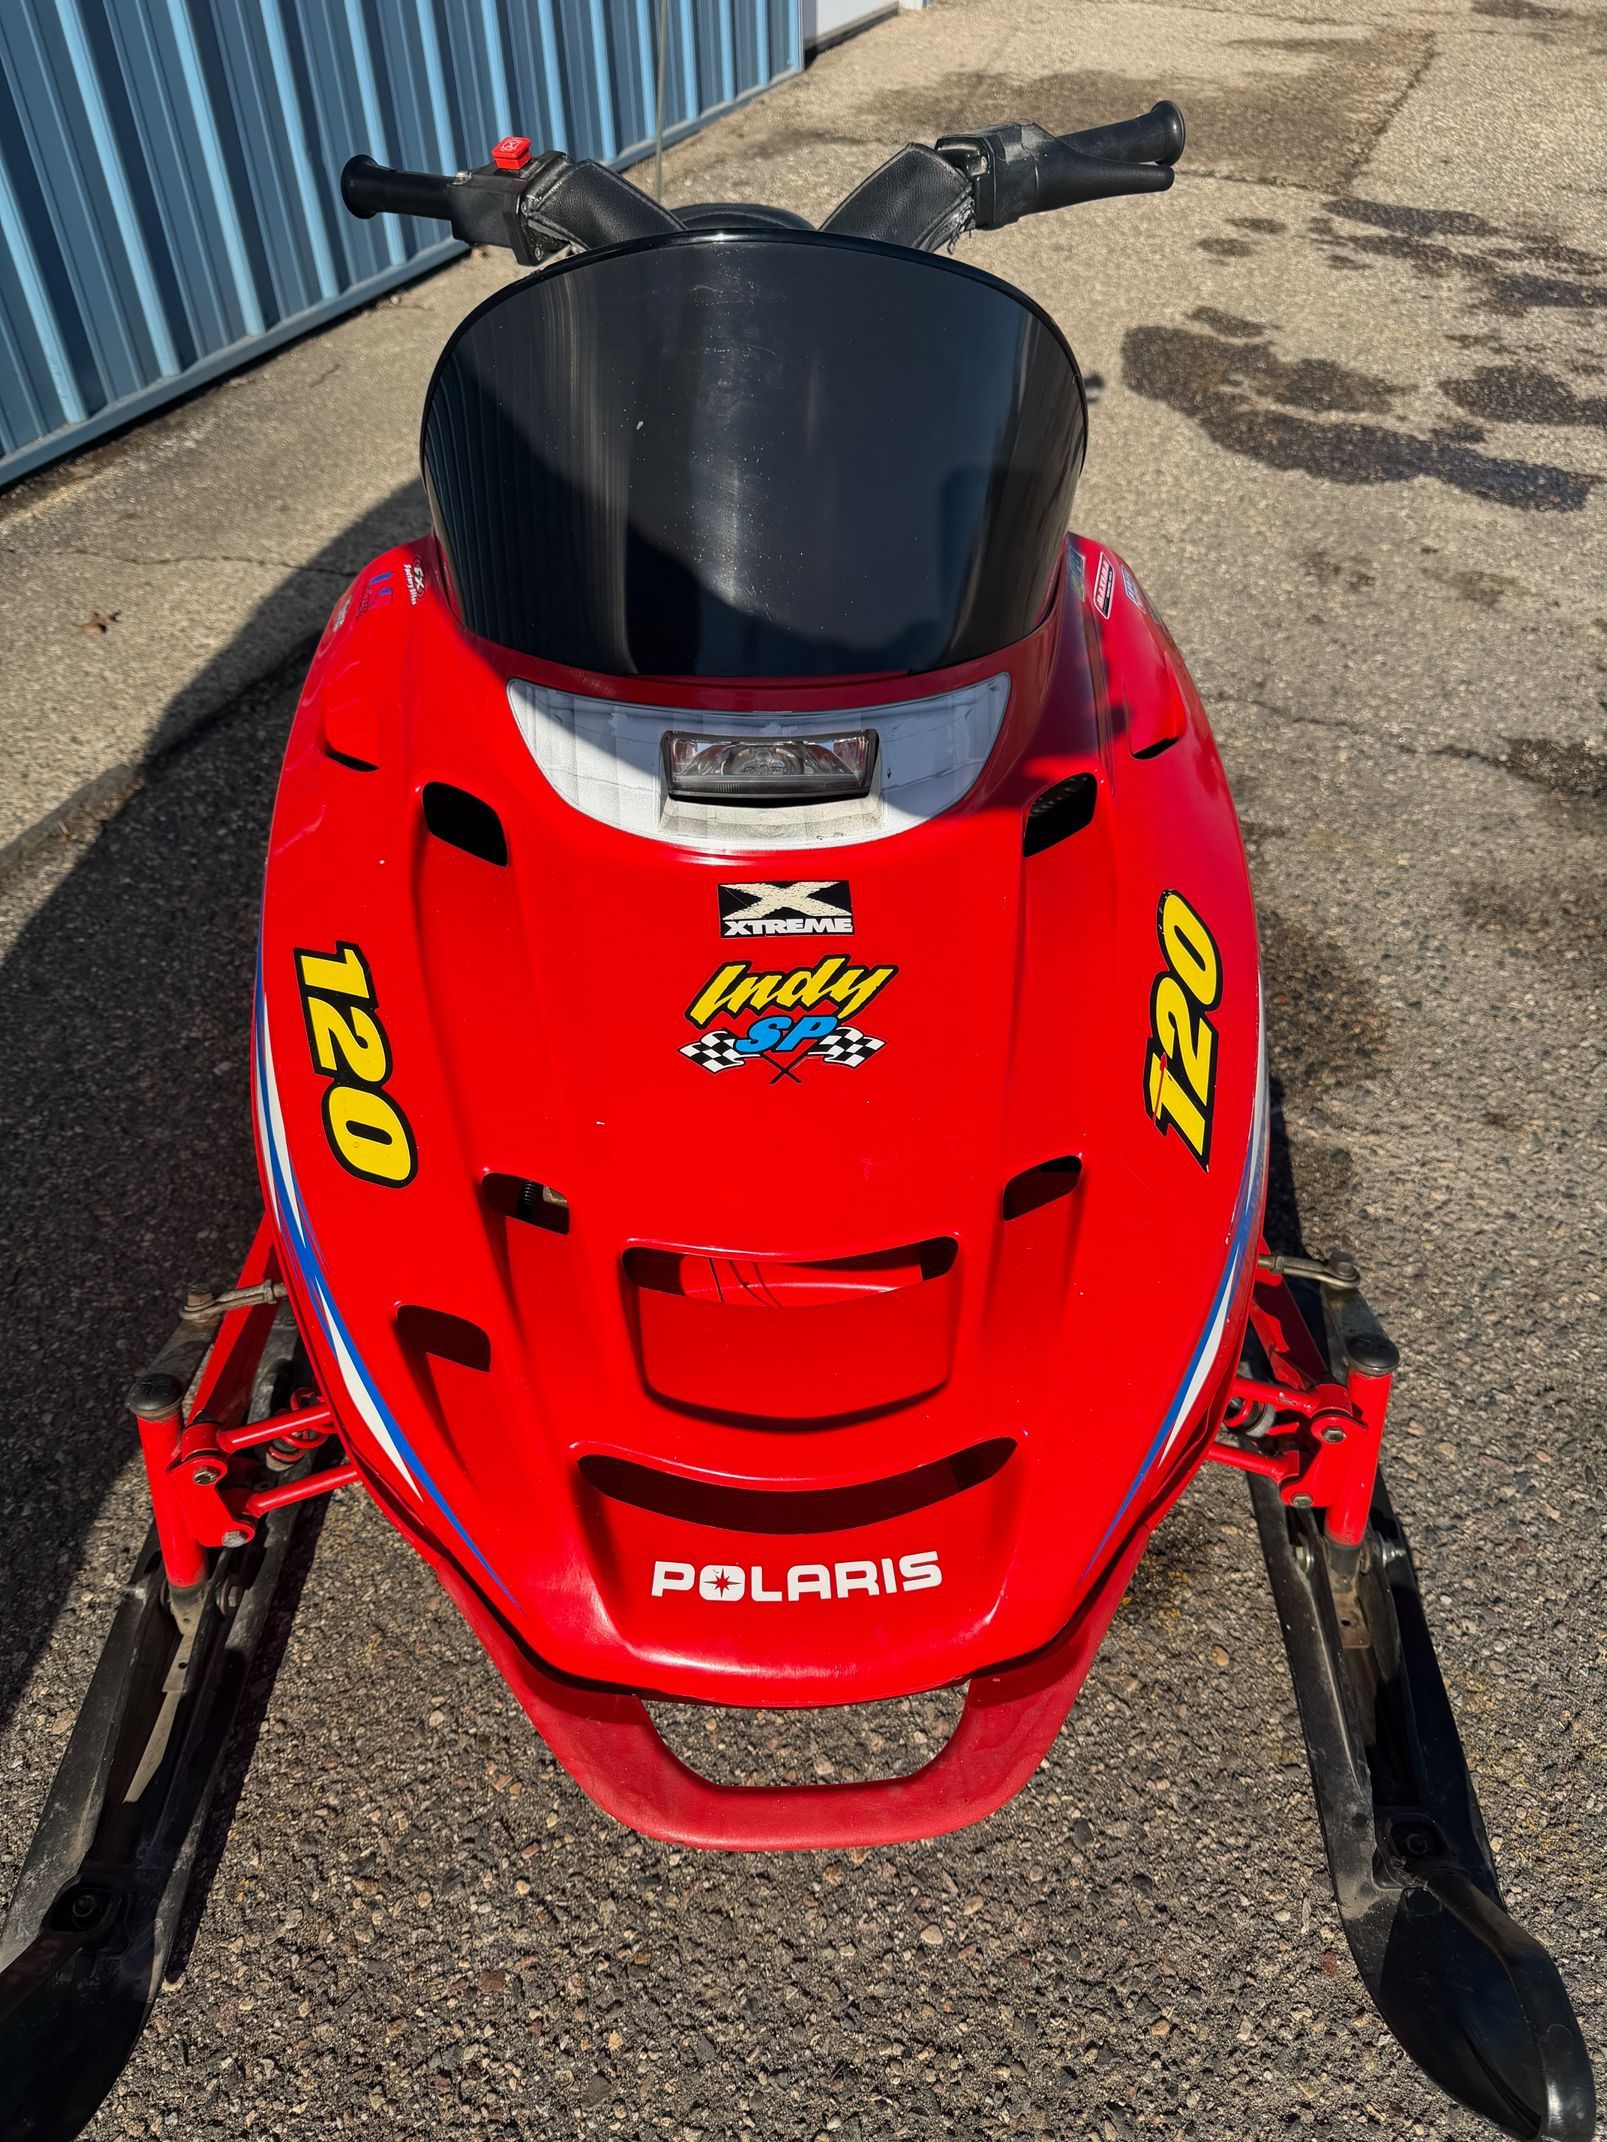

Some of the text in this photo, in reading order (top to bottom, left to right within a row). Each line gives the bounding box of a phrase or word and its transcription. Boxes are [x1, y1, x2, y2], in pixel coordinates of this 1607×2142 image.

[723, 917, 853, 936] XTREME
[687, 956, 896, 1027] Indy
[733, 1015, 837, 1053] SP
[1146, 891, 1221, 1168] 120
[296, 943, 415, 1186] 120
[651, 1551, 943, 1602] POLARIS
